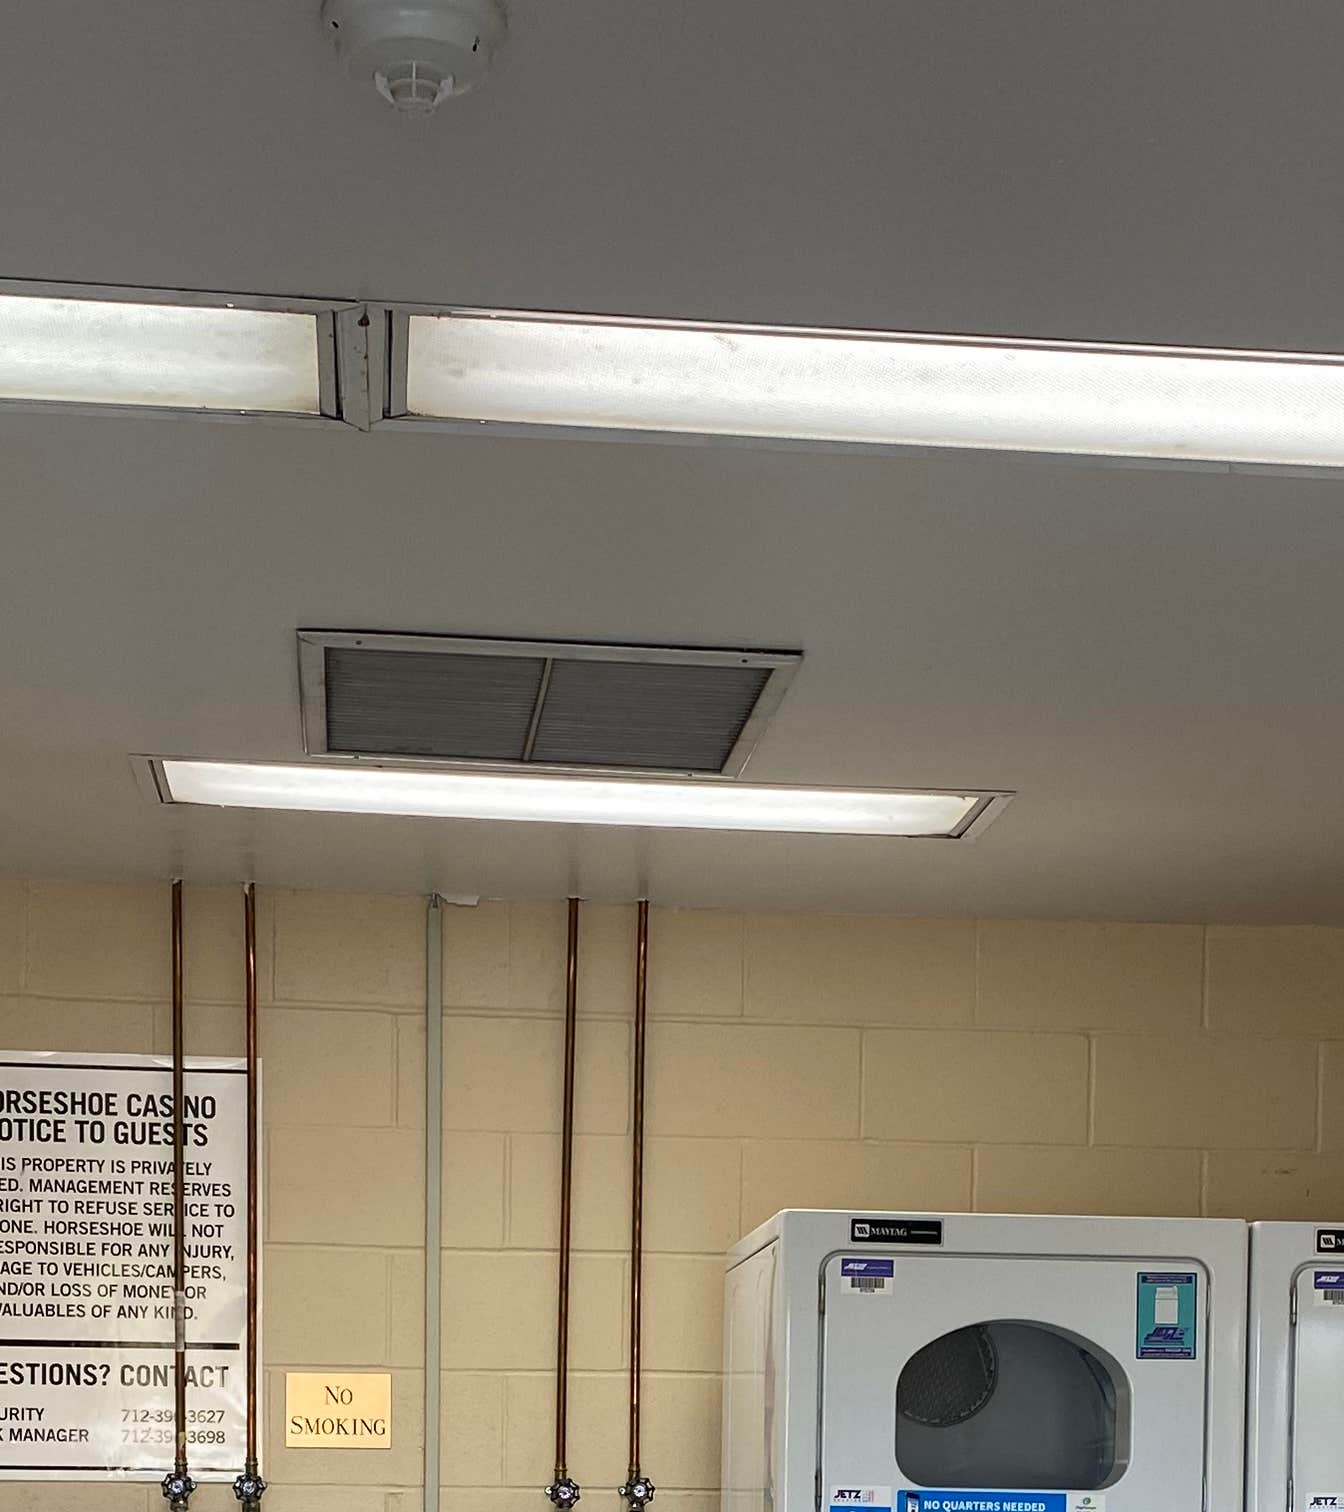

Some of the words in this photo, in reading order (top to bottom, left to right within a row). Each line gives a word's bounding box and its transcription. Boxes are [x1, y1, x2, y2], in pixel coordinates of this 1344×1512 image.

[127, 1094, 216, 1119] CASNO
[75, 1120, 105, 1144] TO
[23, 1158, 105, 1174] PROPERTY
[111, 1160, 125, 1174] IS
[131, 1160, 212, 1176] PRIVAELY
[29, 1179, 144, 1195] MANAGEMENT
[48, 1200, 69, 1215] TO
[74, 1201, 138, 1216] REFUSE
[143, 1202, 209, 1217] SERICE
[215, 1203, 235, 1218] TO
[44, 1221, 143, 1236] HORSESHOE
[148, 1223, 186, 1237] WIL
[192, 1224, 224, 1238] NOT
[871, 1227, 907, 1236] MAYTAG
[101, 1243, 132, 1257] FOR
[138, 1244, 170, 1258] ANY
[179, 1244, 235, 1261] NJURY,
[37, 1262, 57, 1276] TO
[51, 1283, 92, 1298] LOSS
[97, 1284, 117, 1298] OF
[185, 1286, 207, 1300] OR
[91, 1304, 112, 1318] OF
[117, 1305, 149, 1319] ANY
[120, 1364, 229, 1388] CONACT
[323, 1385, 353, 1405] NO
[121, 1409, 225, 1424] 712-393627
[290, 1415, 386, 1436] SMOKING
[9, 1428, 89, 1443] MANAGER
[121, 1429, 226, 1444] 712-393698
[834, 1489, 861, 1500] JETZ
[1309, 1497, 1338, 1507] JETZ
[923, 1500, 940, 1511] NO
[1003, 1501, 1047, 1512] NEEDED
